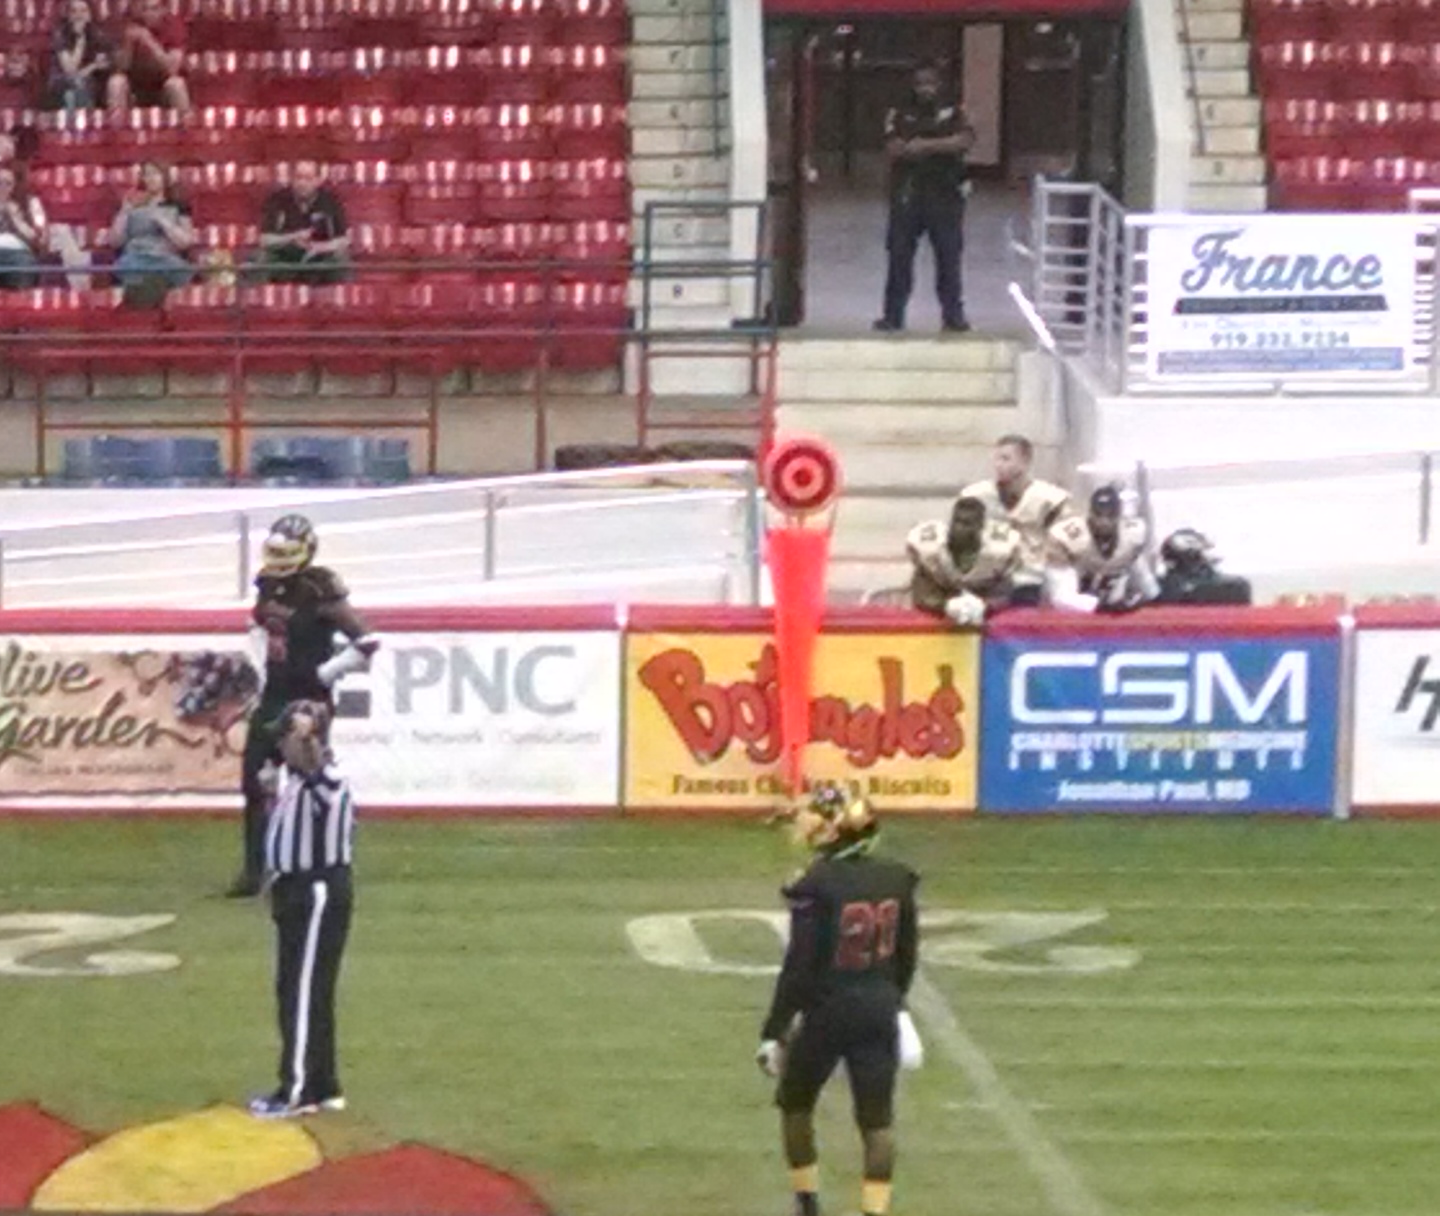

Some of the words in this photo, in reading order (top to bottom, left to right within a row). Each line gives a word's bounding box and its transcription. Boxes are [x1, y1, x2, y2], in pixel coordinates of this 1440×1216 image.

[1180, 228, 1384, 292] France
[393, 645, 577, 716] PNC
[1009, 650, 1309, 725] CSM
[672, 774, 749, 796] Famous
[869, 775, 951, 796] Biscuits
